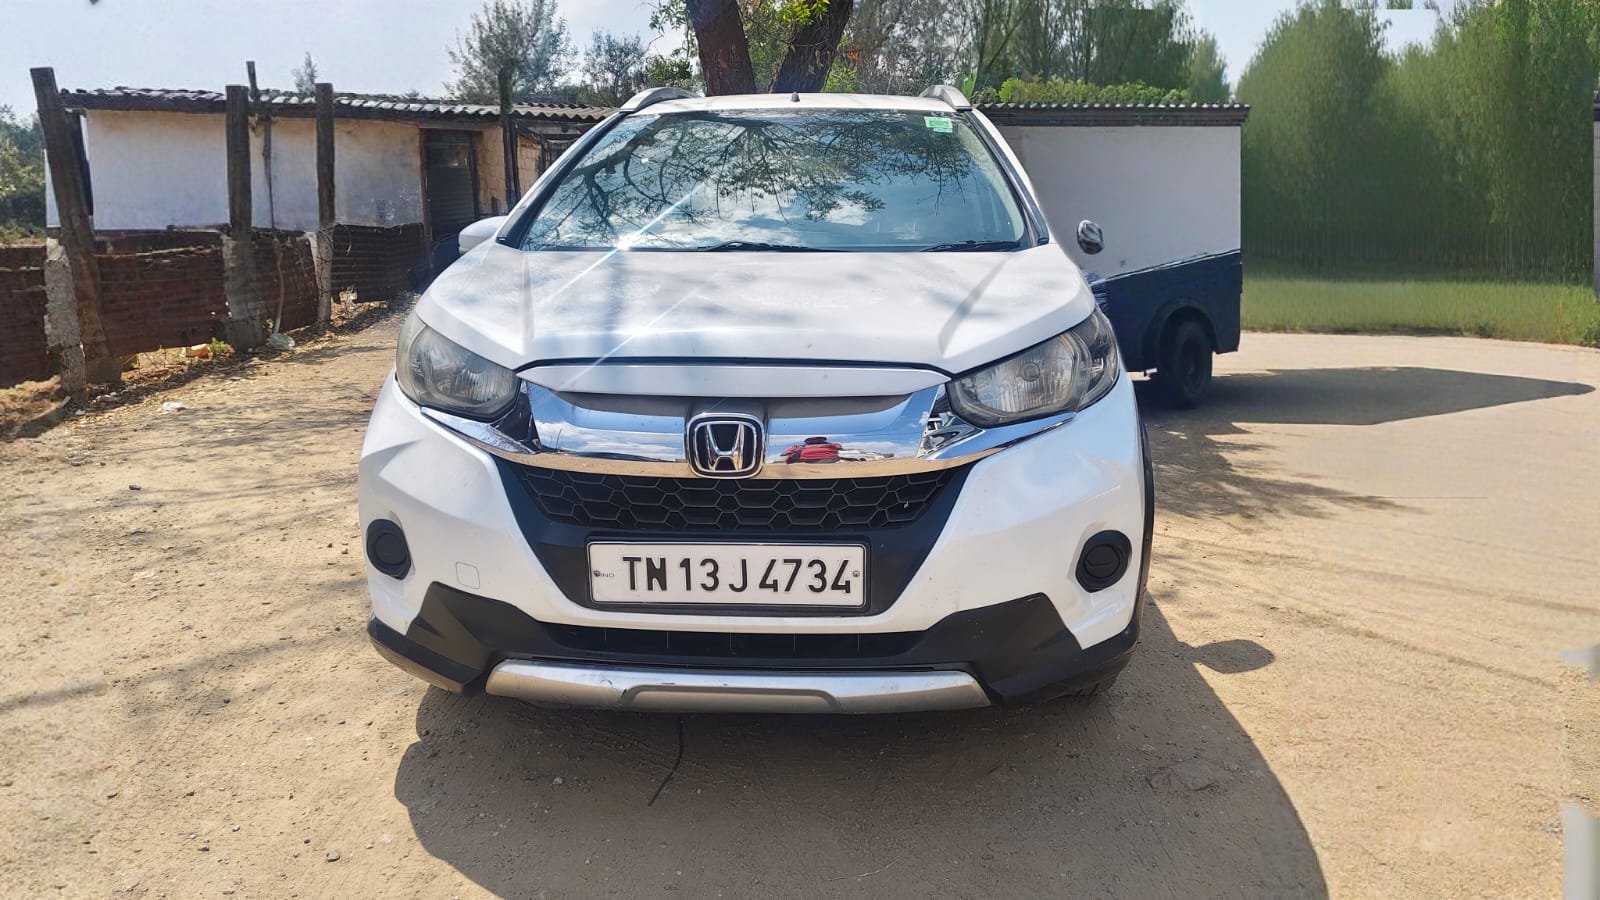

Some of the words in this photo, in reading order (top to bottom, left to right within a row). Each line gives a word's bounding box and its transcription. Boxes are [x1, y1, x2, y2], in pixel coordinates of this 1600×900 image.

[622, 556, 668, 592] TN
[679, 557, 720, 592] 13
[728, 558, 748, 593] J
[758, 558, 852, 594] 4734
